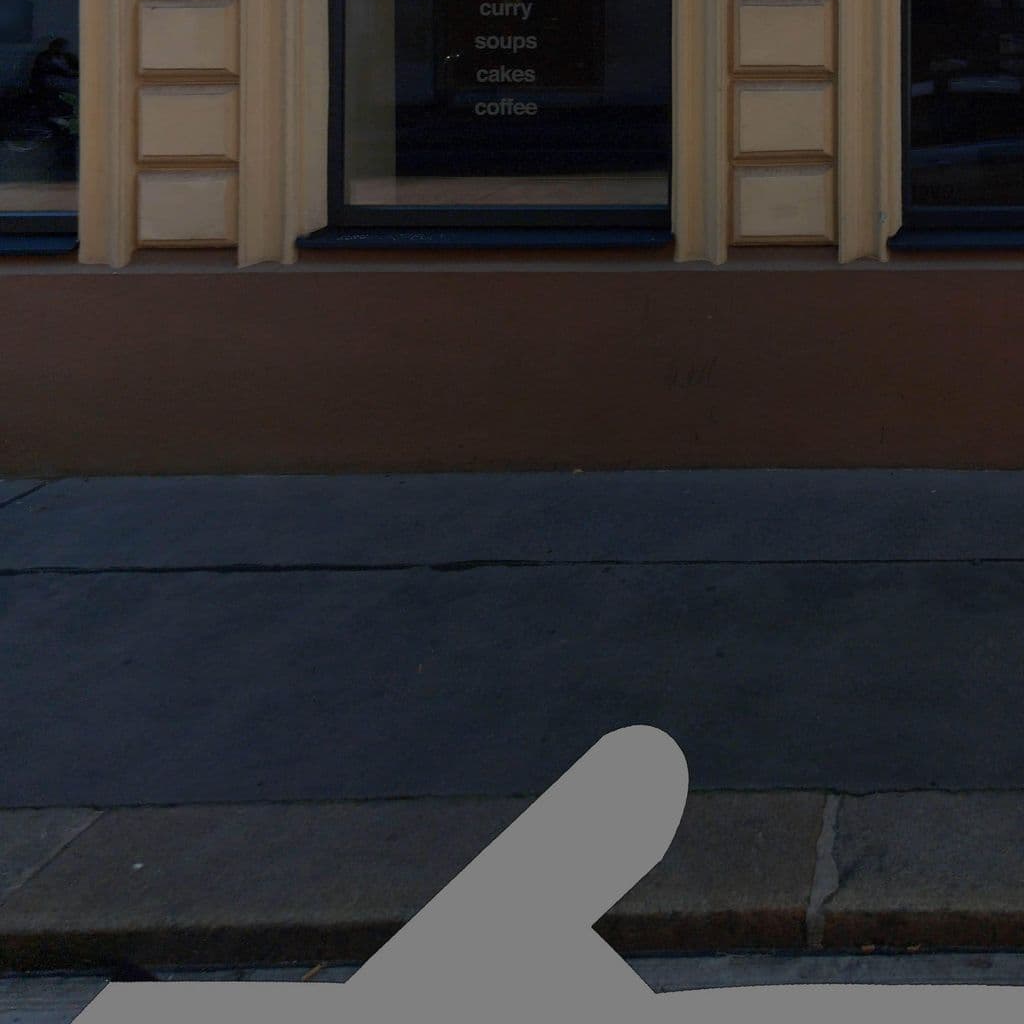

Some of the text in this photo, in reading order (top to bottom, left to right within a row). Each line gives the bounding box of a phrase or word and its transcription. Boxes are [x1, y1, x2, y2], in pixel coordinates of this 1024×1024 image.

[479, 2, 533, 20] curry
[474, 34, 537, 53] soups
[476, 65, 536, 83] cakes
[474, 98, 538, 116] coffee
